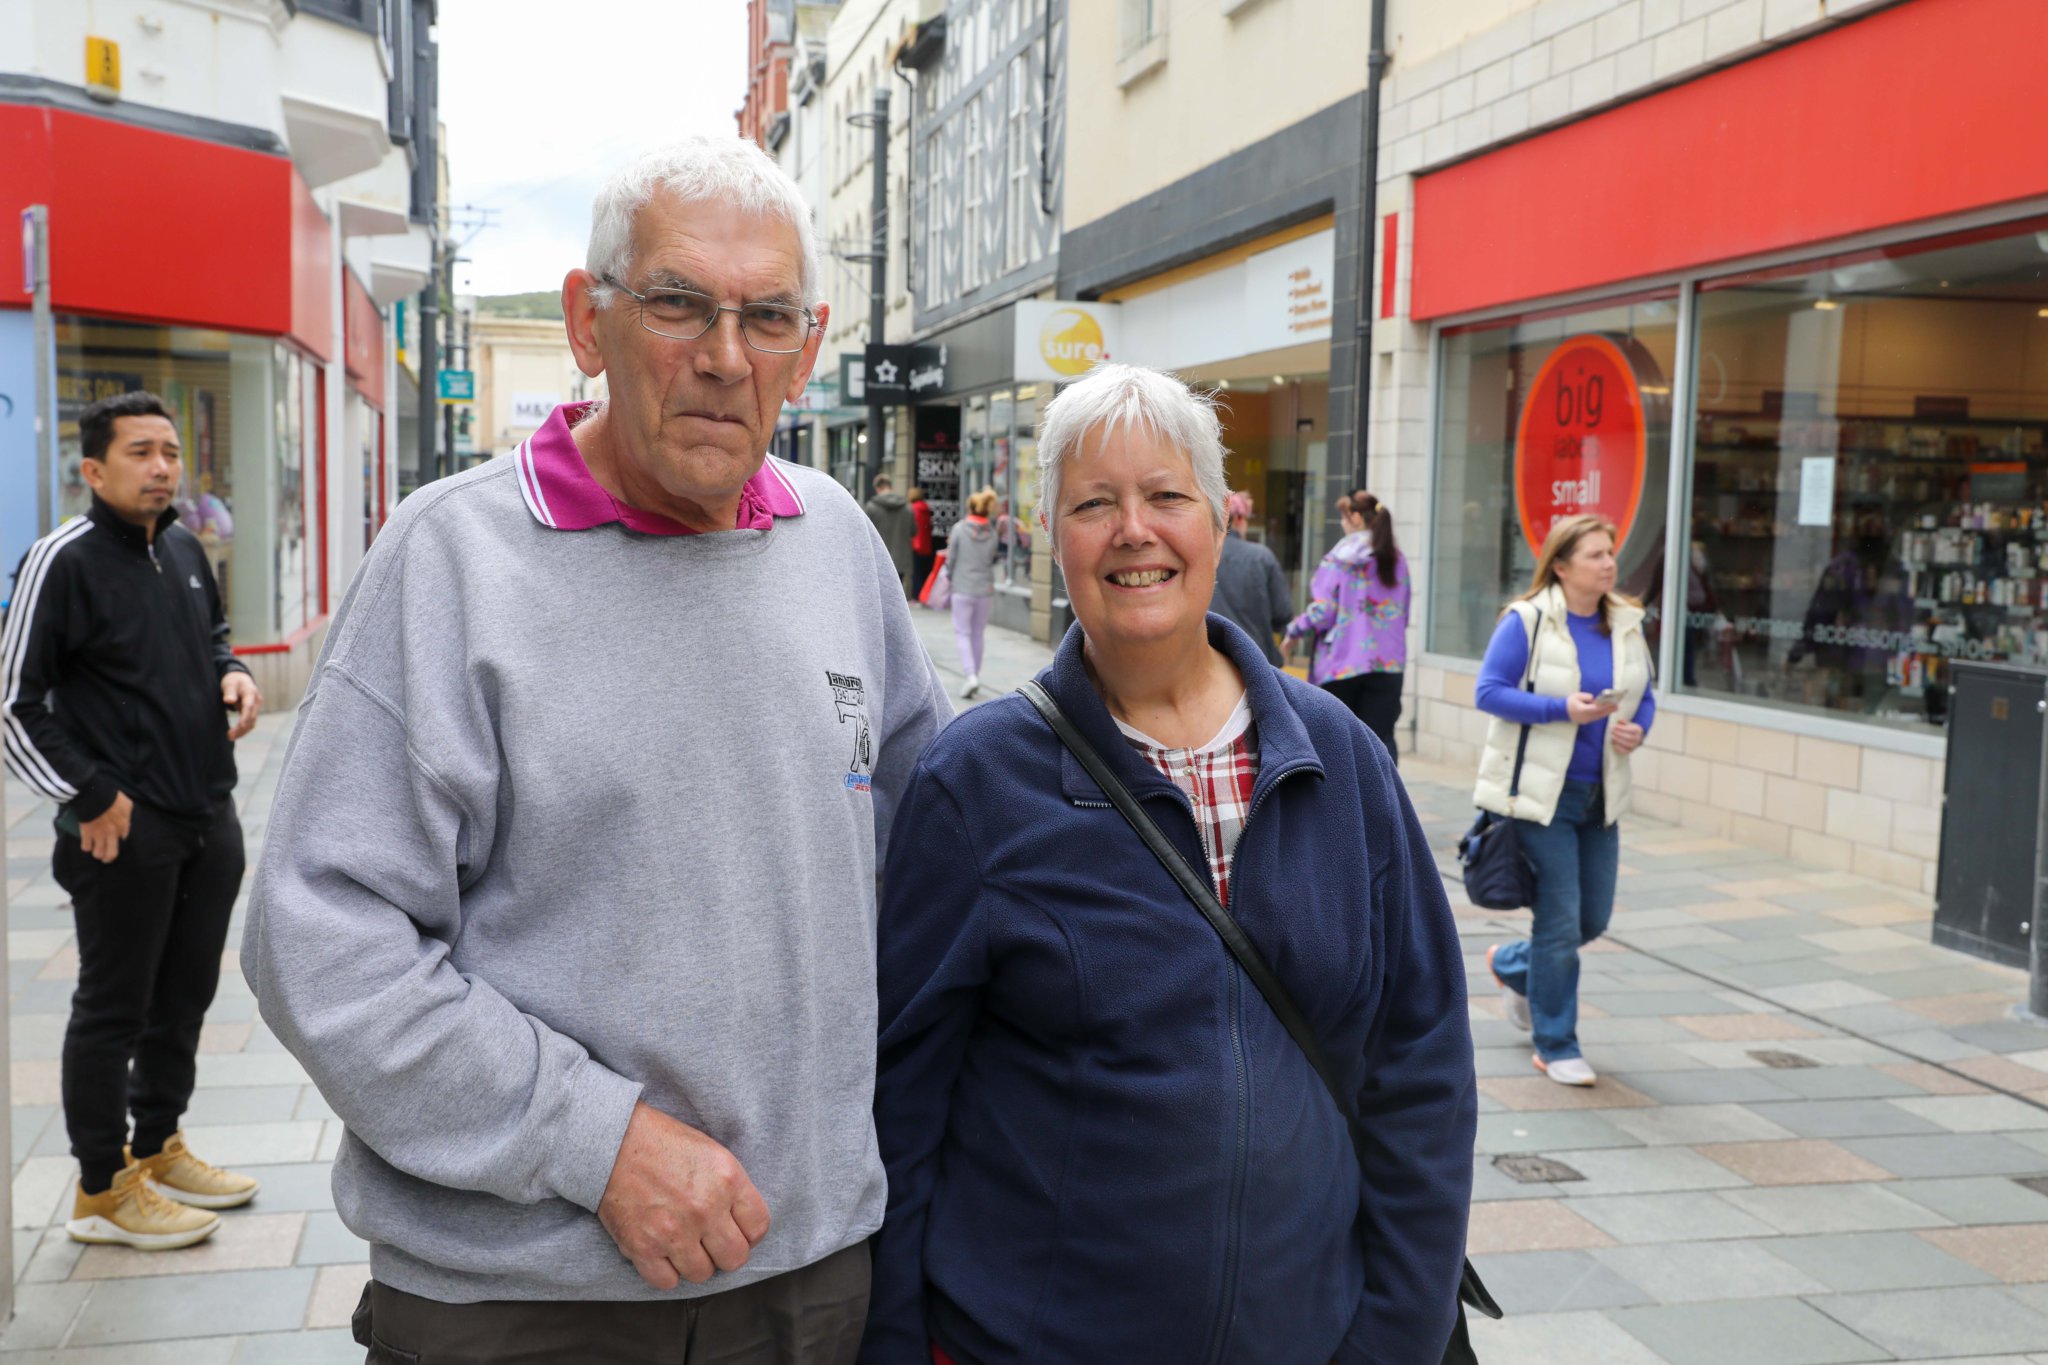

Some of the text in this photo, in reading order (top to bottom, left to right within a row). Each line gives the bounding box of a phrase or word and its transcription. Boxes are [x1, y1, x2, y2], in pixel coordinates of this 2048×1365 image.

[1556, 367, 1603, 428] big
[918, 460, 960, 477] SKIN
[1552, 470, 1600, 506] small
